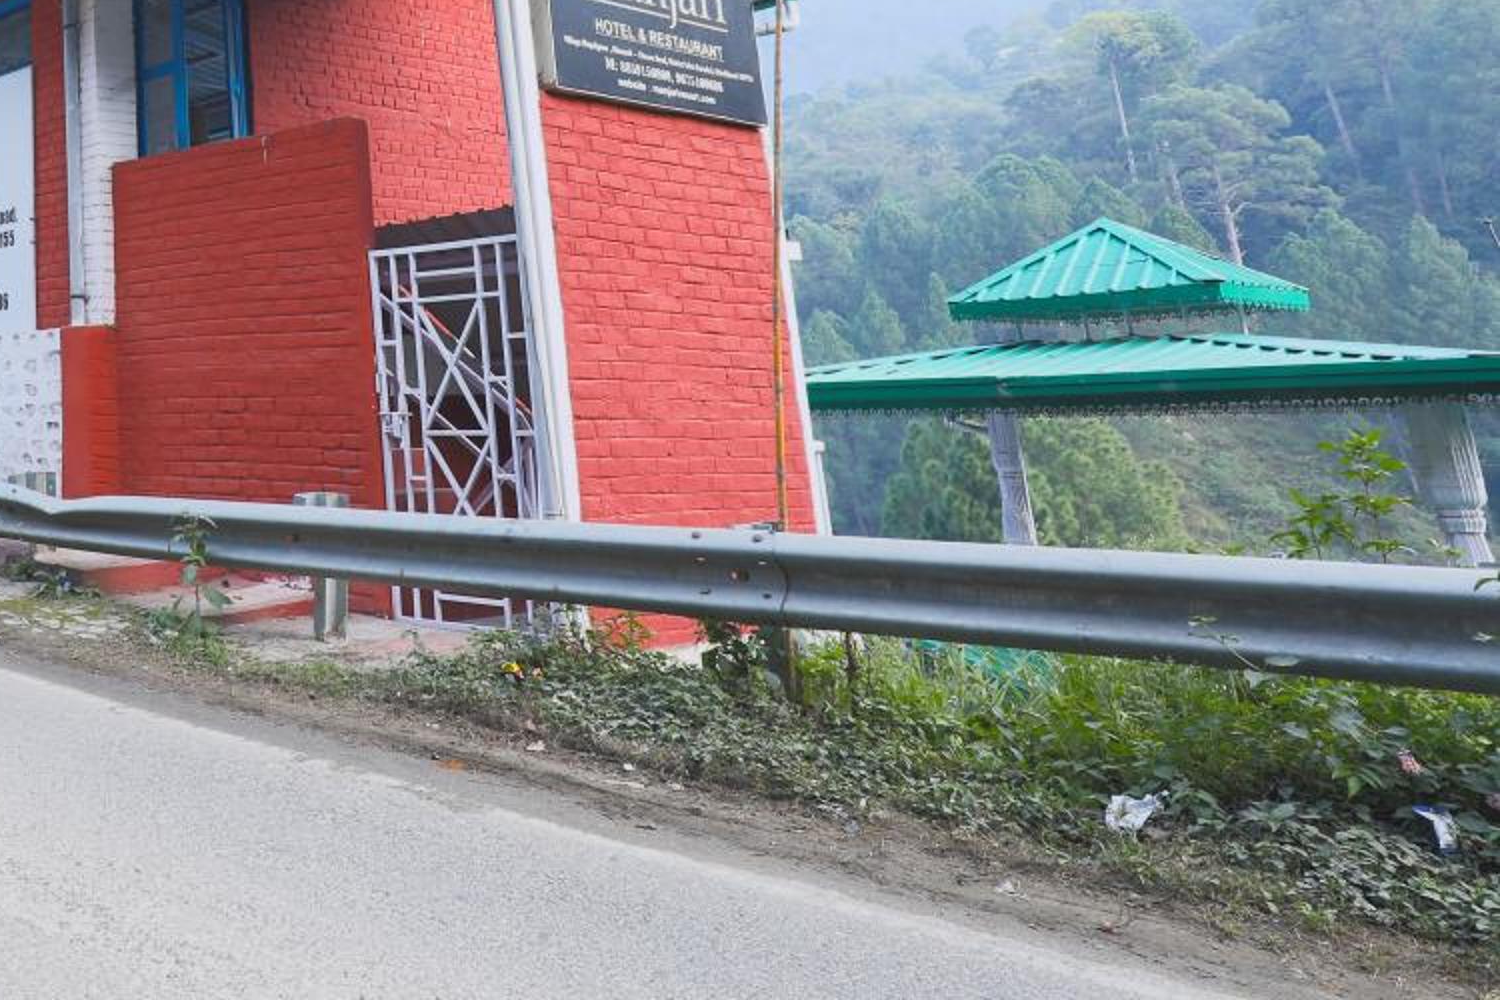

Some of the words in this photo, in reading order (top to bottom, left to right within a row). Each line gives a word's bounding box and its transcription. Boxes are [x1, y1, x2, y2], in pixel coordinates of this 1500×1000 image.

[595, 18, 637, 43] HOTEL
[638, 28, 646, 44] &
[648, 30, 724, 62] RESTAURANT
